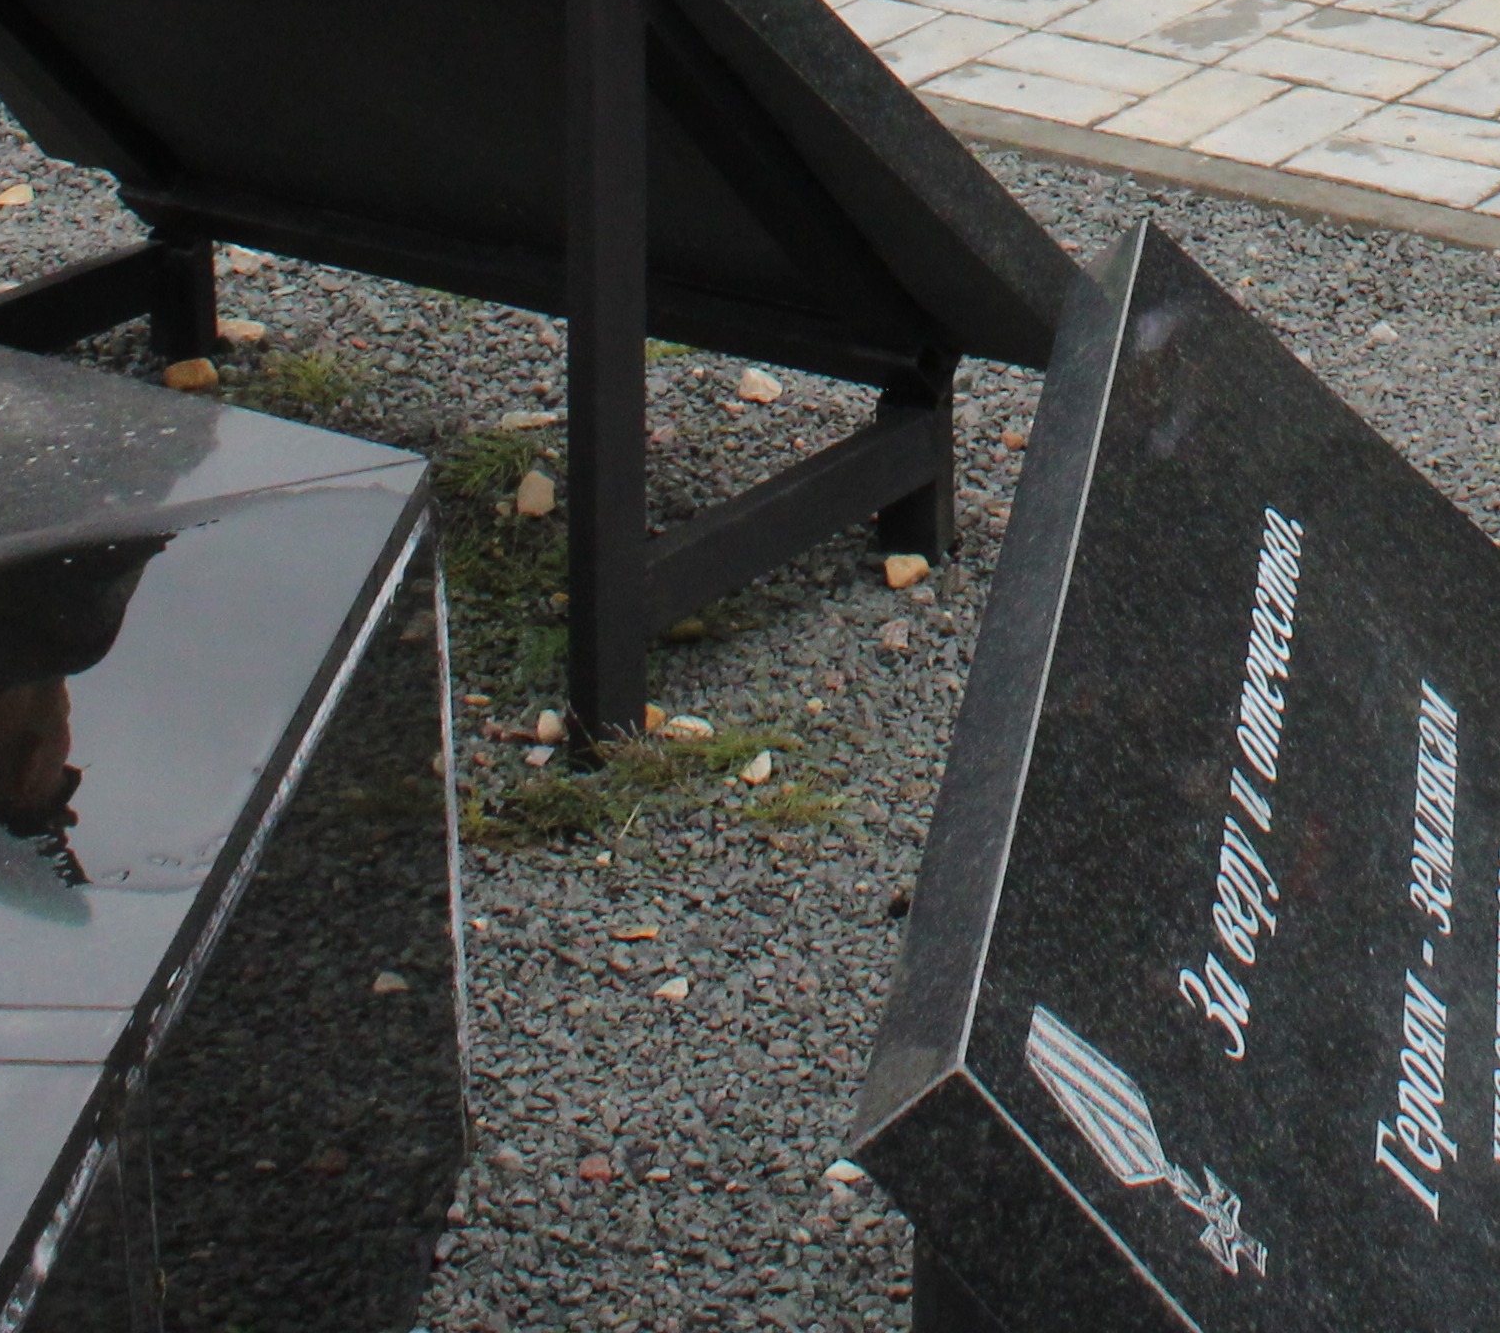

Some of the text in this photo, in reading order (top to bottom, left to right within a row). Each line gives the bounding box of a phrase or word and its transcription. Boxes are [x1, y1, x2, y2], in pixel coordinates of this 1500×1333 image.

[1177, 506, 1305, 1061] За веру и отечество.
[1409, 678, 1459, 935] землякам
[1374, 968, 1458, 1222] Героям
